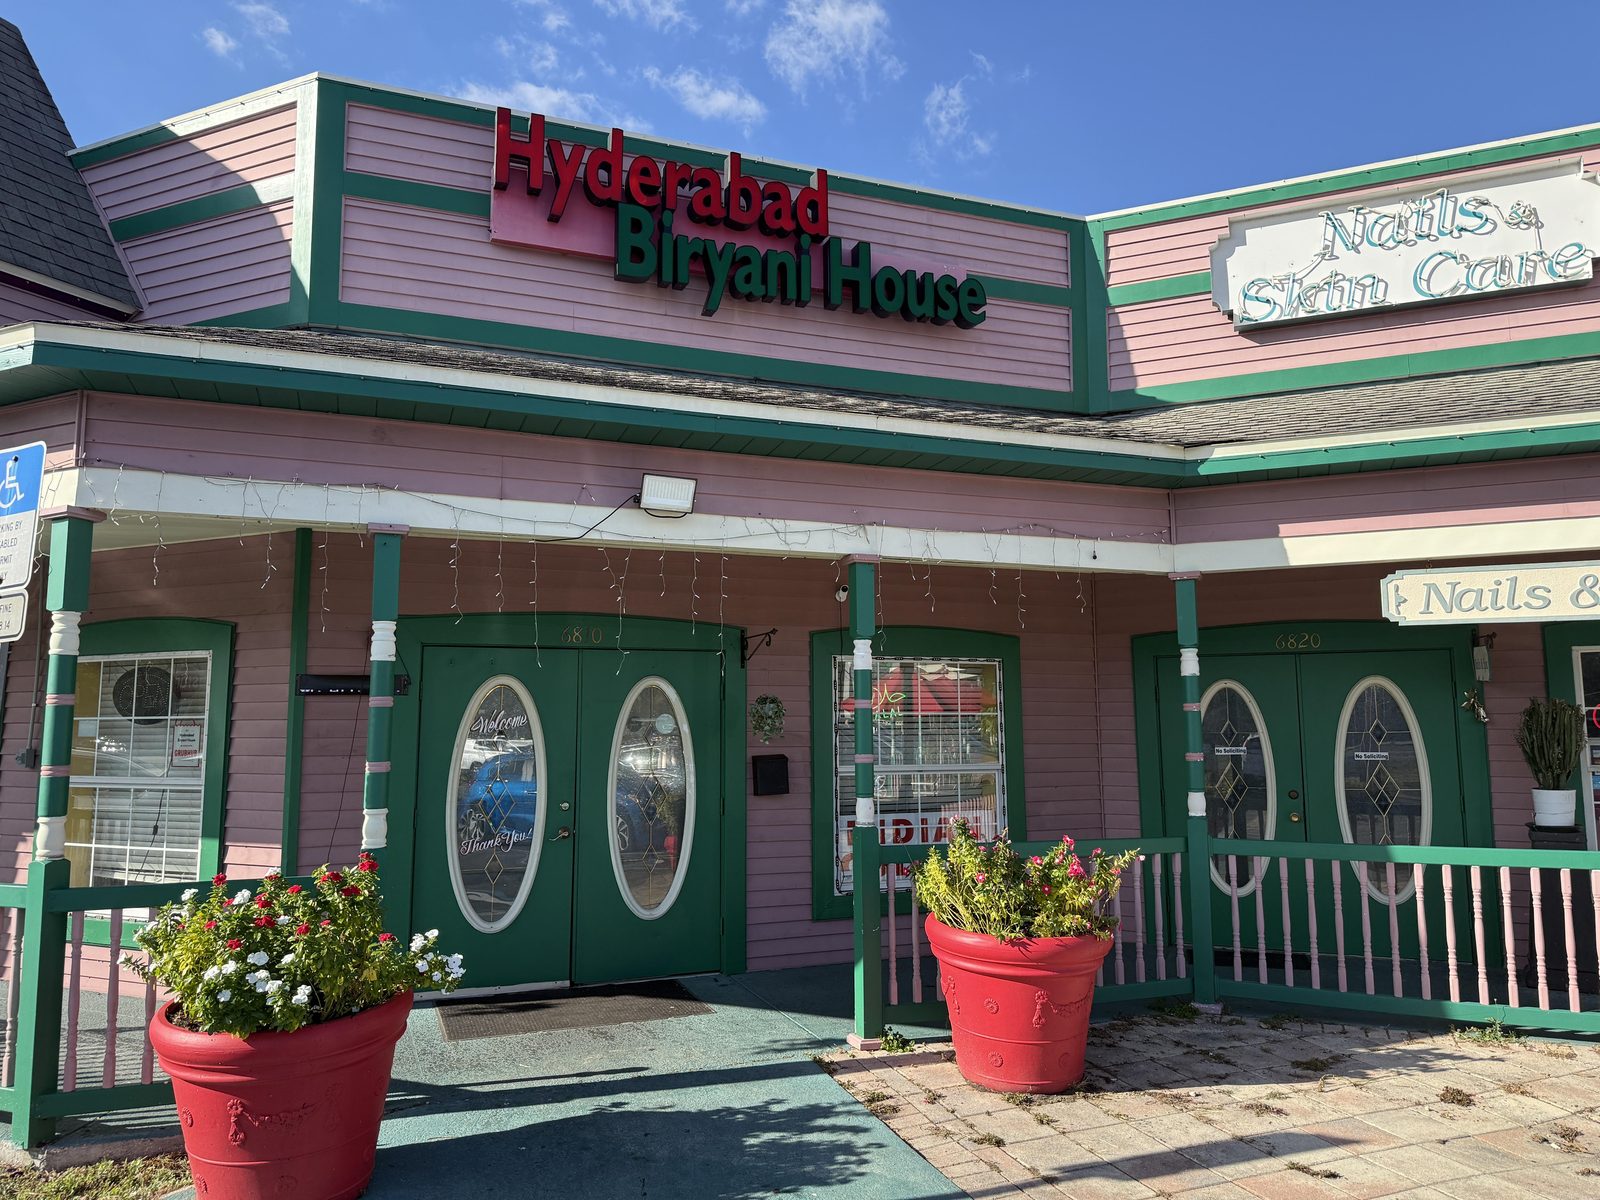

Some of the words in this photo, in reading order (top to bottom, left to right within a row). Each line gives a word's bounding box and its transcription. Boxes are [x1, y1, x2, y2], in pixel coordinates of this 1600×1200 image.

[493, 107, 830, 243] Hyderabad
[1318, 187, 1489, 252] Nails
[614, 203, 812, 316] Biryani
[823, 236, 987, 330] House
[1239, 270, 1387, 322] Skin
[1412, 242, 1588, 298] Care
[1419, 575, 1552, 614] Nails
[1569, 573, 1600, 609] &
[1275, 632, 1321, 649] 6820
[470, 709, 528, 733] Welcome
[460, 833, 501, 855] Thank
[501, 827, 533, 853] You!
[847, 816, 981, 846] IDIAN
